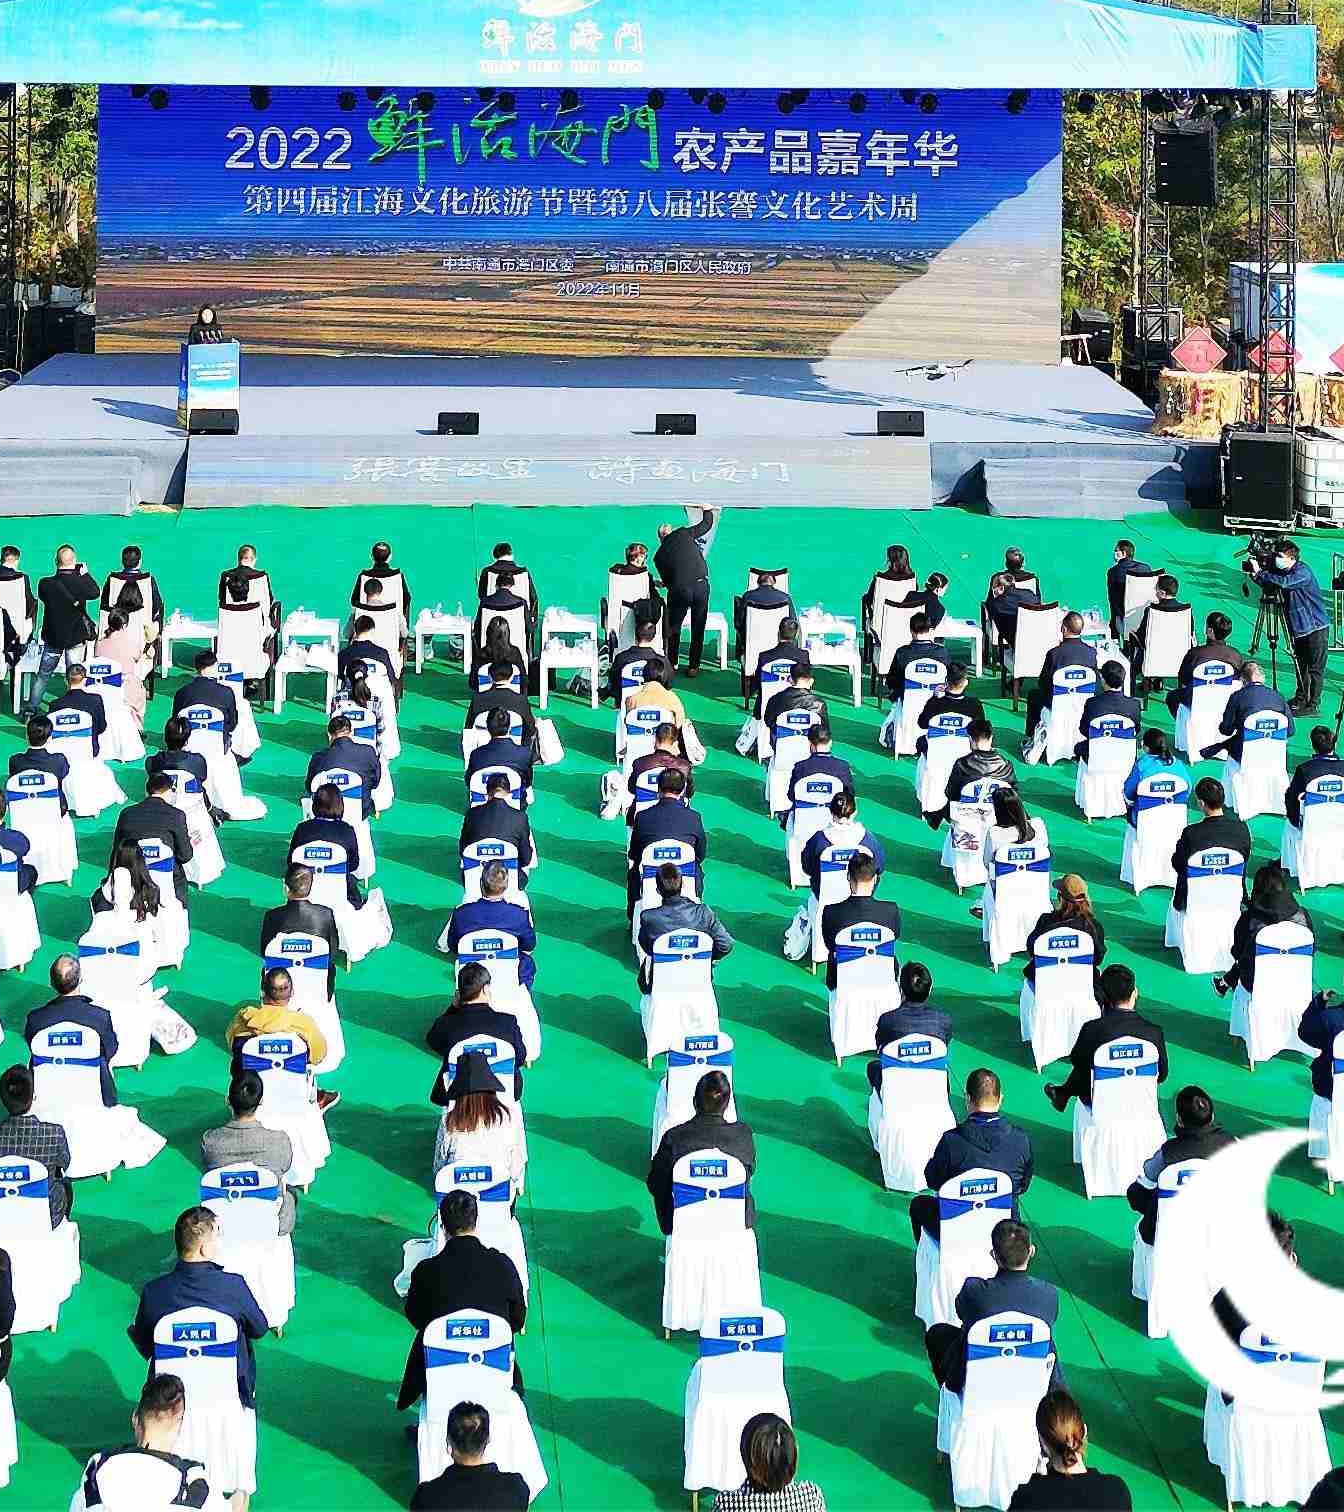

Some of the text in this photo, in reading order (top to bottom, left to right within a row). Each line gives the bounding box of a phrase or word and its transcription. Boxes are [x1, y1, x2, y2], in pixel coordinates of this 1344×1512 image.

[224, 126, 353, 170] 2022
[672, 126, 960, 178] 农产品嘉年华
[555, 280, 641, 298] 2022年11月
